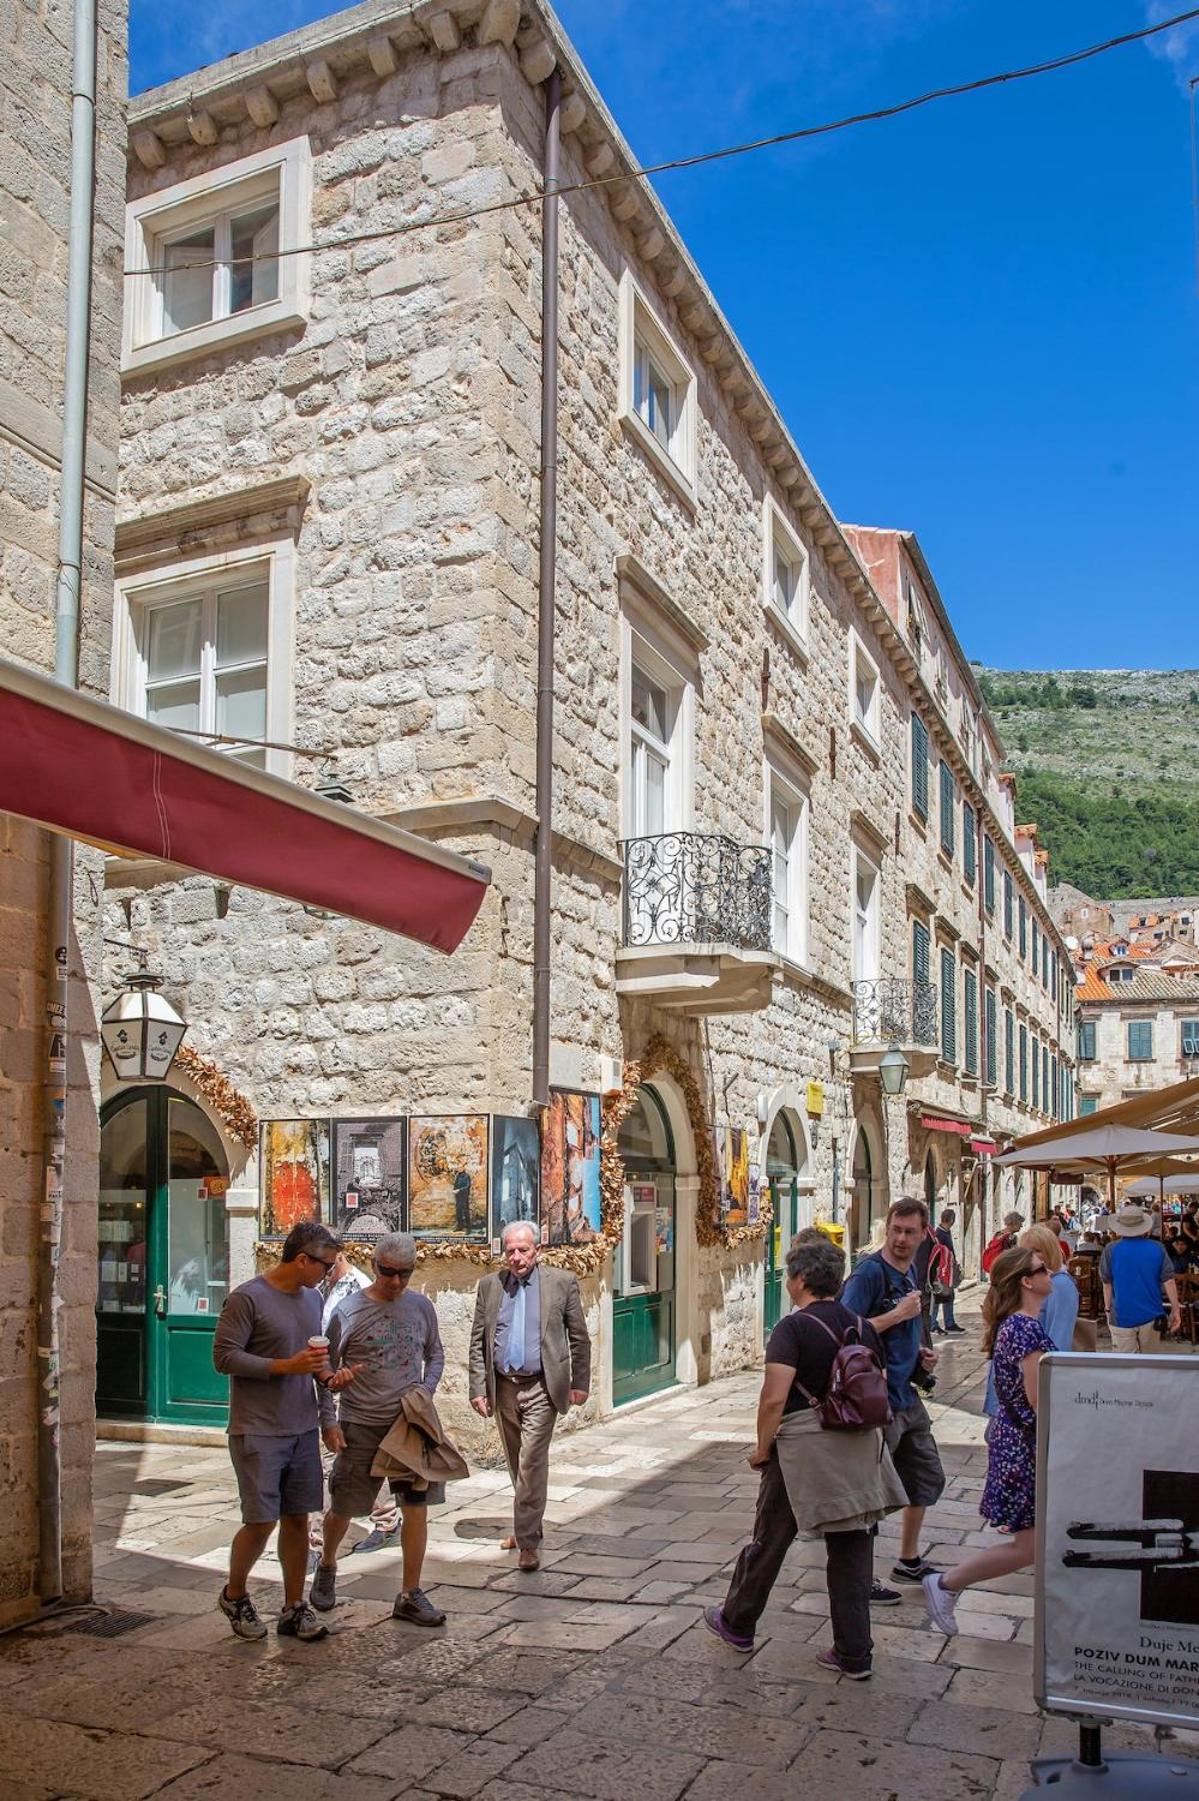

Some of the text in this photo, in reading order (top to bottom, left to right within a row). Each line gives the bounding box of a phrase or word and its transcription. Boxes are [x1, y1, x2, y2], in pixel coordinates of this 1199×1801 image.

[1139, 1636, 1174, 1653] Duje
[1074, 1646, 1199, 1672] POZIV DUM MAR
[1074, 1661, 1094, 1670] THE
[1097, 1665, 1145, 1678] CALLING
[1149, 1671, 1166, 1680] OF
[1073, 1673, 1086, 1681] LA
[1088, 1676, 1154, 1691] VOCAZIONE
[1157, 1684, 1169, 1694] DI
